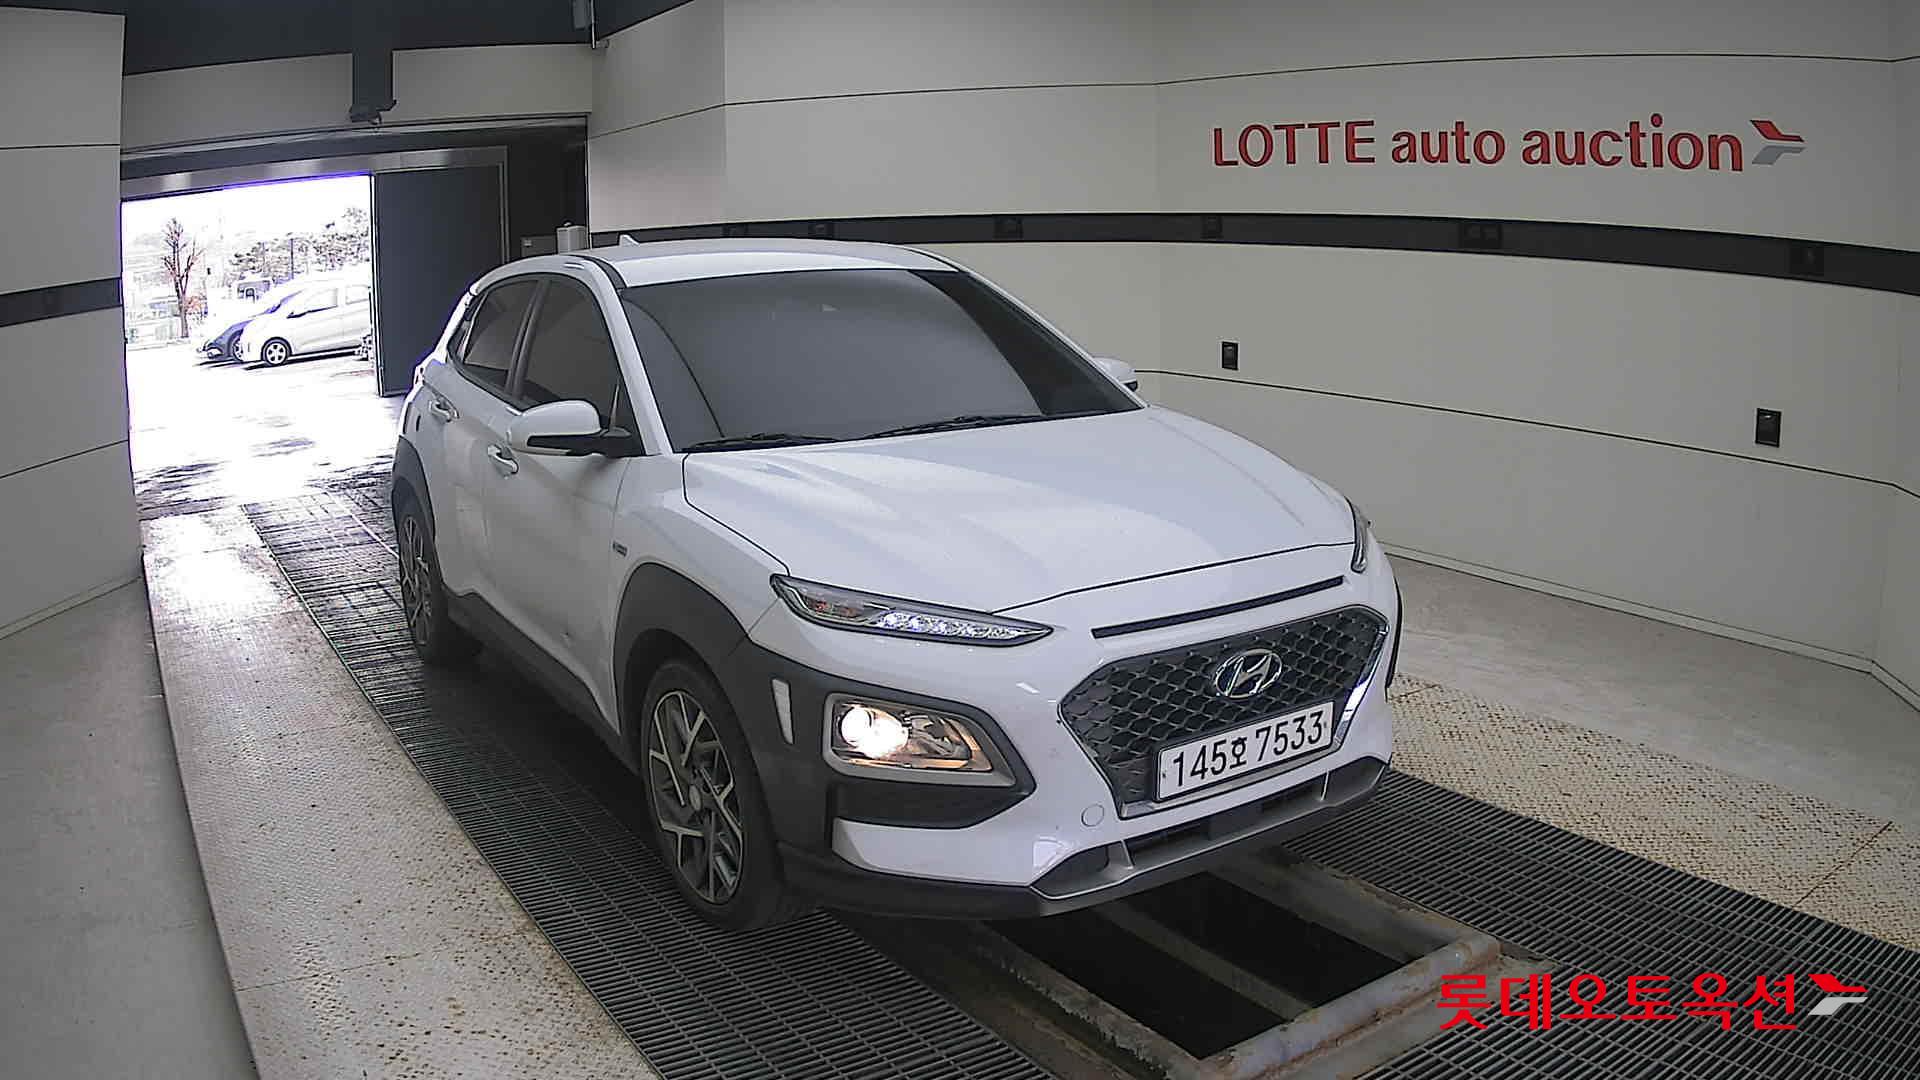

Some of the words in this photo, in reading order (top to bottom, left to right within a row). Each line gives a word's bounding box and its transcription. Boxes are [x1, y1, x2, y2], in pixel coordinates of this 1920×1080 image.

[1213, 120, 1376, 168] LOTTE
[1391, 121, 1506, 166] auto
[1522, 113, 1743, 171] auction
[1172, 737, 1248, 787] 145호
[1255, 710, 1325, 762] 7533
